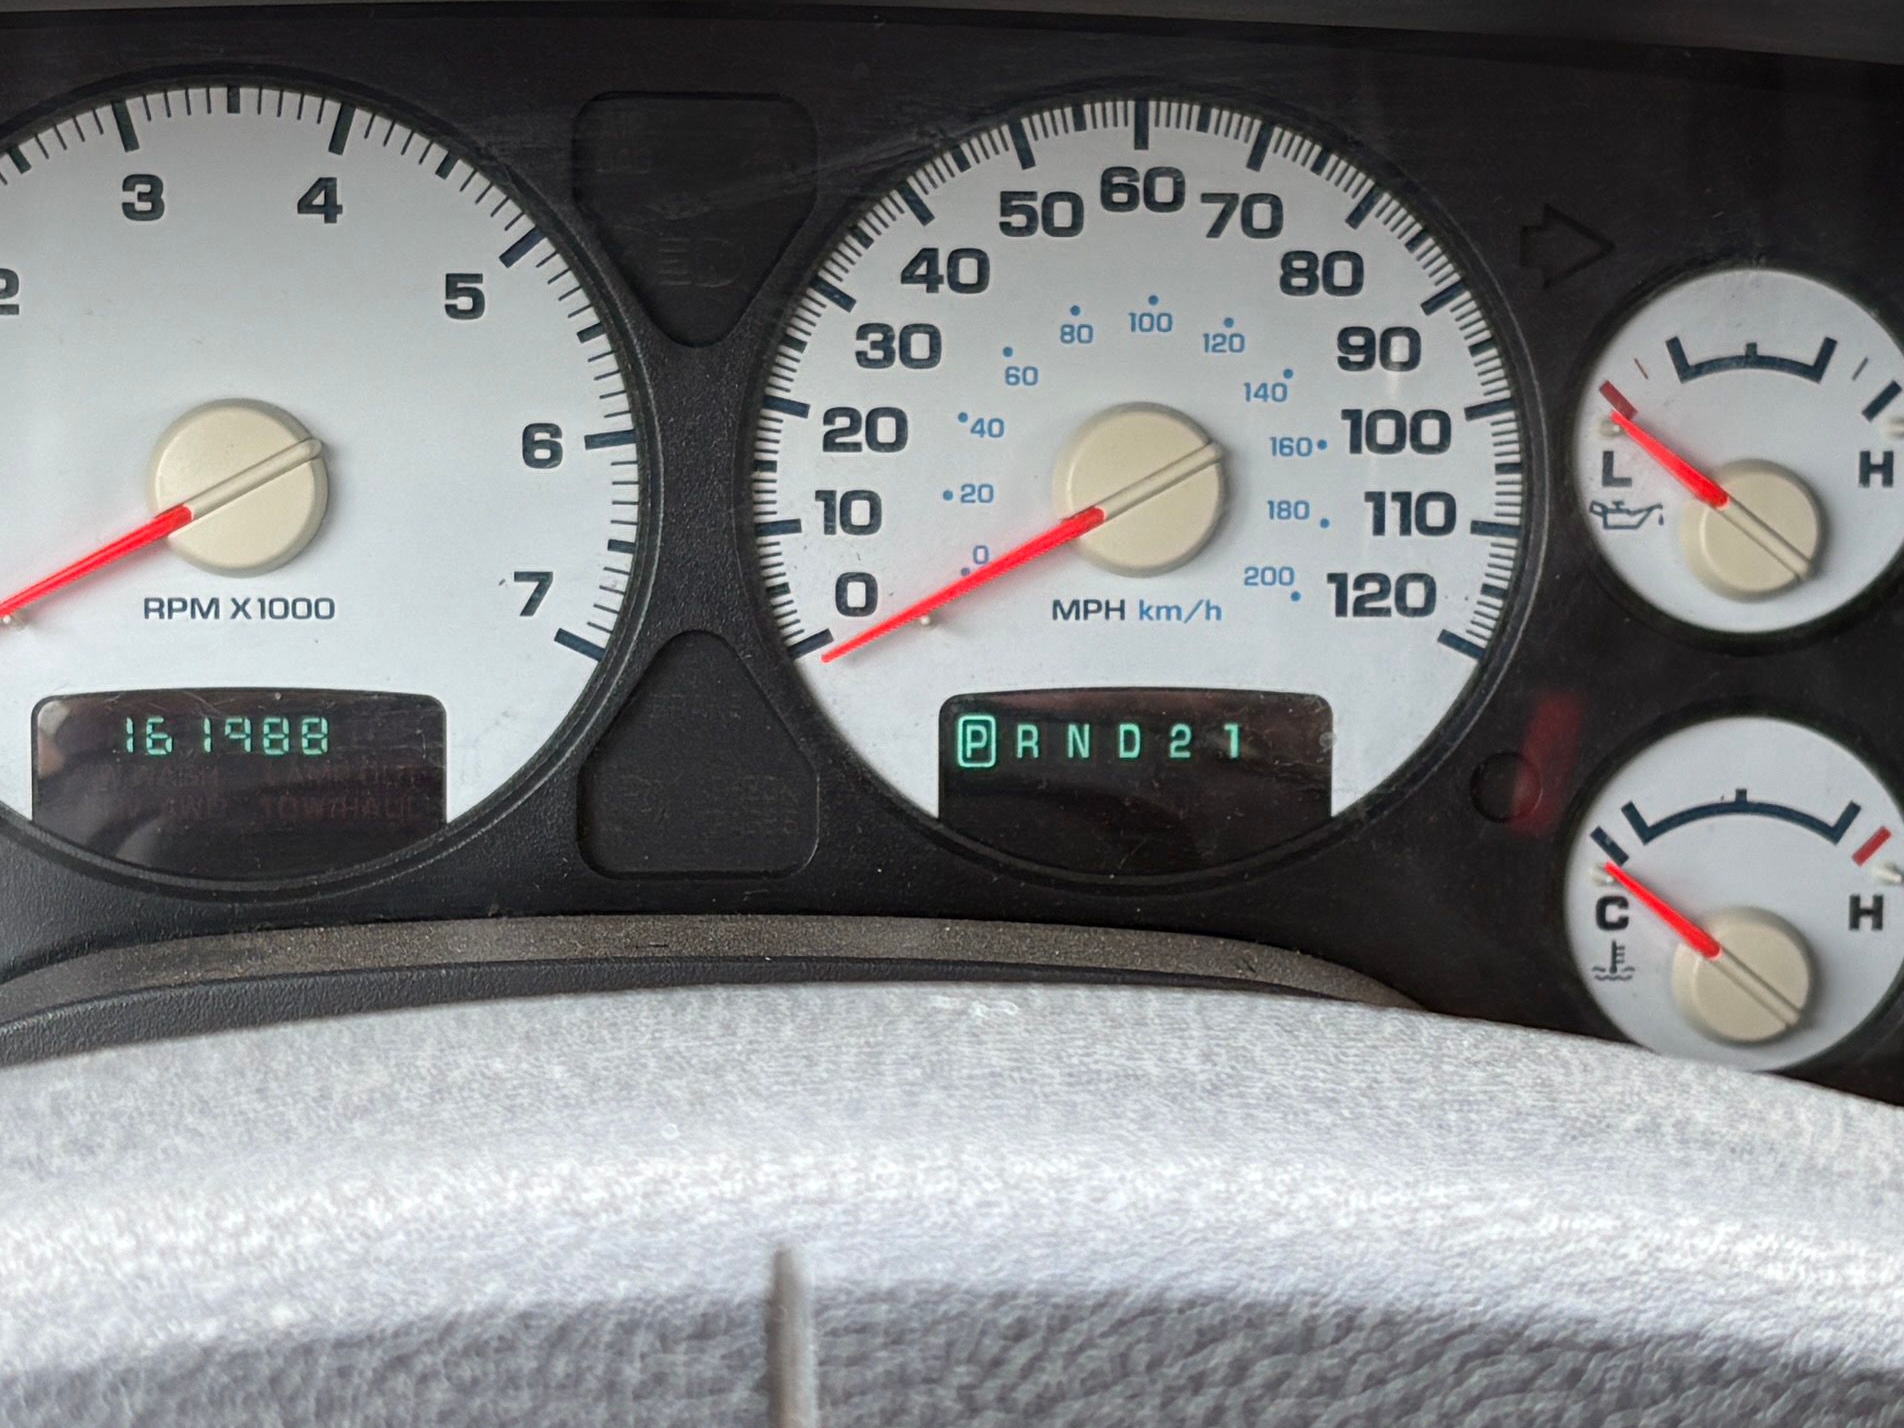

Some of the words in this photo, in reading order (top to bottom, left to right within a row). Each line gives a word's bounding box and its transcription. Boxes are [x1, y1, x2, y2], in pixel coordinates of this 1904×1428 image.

[121, 173, 166, 222] 3
[296, 176, 344, 225] 4
[1099, 165, 1187, 214] 60
[998, 190, 1085, 238] 50
[1199, 191, 1285, 240] 70
[900, 246, 991, 295] 40
[1278, 249, 1365, 297] 80
[444, 272, 486, 320] 5
[1059, 323, 1094, 345] 80
[1127, 311, 1174, 333] 100
[1202, 332, 1246, 354] 120
[854, 322, 942, 370] 30
[1336, 325, 1422, 372] 90
[1004, 365, 1039, 387] 60
[1243, 381, 1289, 403] 140
[521, 422, 563, 469] 6
[822, 406, 909, 453] 20
[969, 417, 1005, 439] 40
[1269, 436, 1314, 458] 160
[1340, 408, 1452, 455] 100
[1601, 450, 1632, 487] L
[1858, 449, 1895, 488] H
[814, 489, 882, 536] 10
[959, 483, 995, 504] 20
[1267, 499, 1311, 521] 180
[1364, 490, 1457, 537] 110
[972, 544, 990, 565] 0
[513, 571, 553, 617] 7
[834, 571, 878, 617] 0
[1243, 566, 1296, 587] 200
[1326, 572, 1437, 618] 120
[144, 597, 220, 620] RPM
[1052, 599, 1126, 621] MPH
[1138, 599, 1222, 624] km/h
[123, 715, 331, 758] 161988
[966, 723, 988, 759] P
[1016, 723, 1039, 759] R
[1067, 723, 1090, 759] N
[1118, 722, 1141, 759] D
[1169, 723, 1192, 758] 2
[1223, 723, 1239, 759] 1
[1595, 895, 1630, 932] C
[1848, 894, 1885, 932] H
